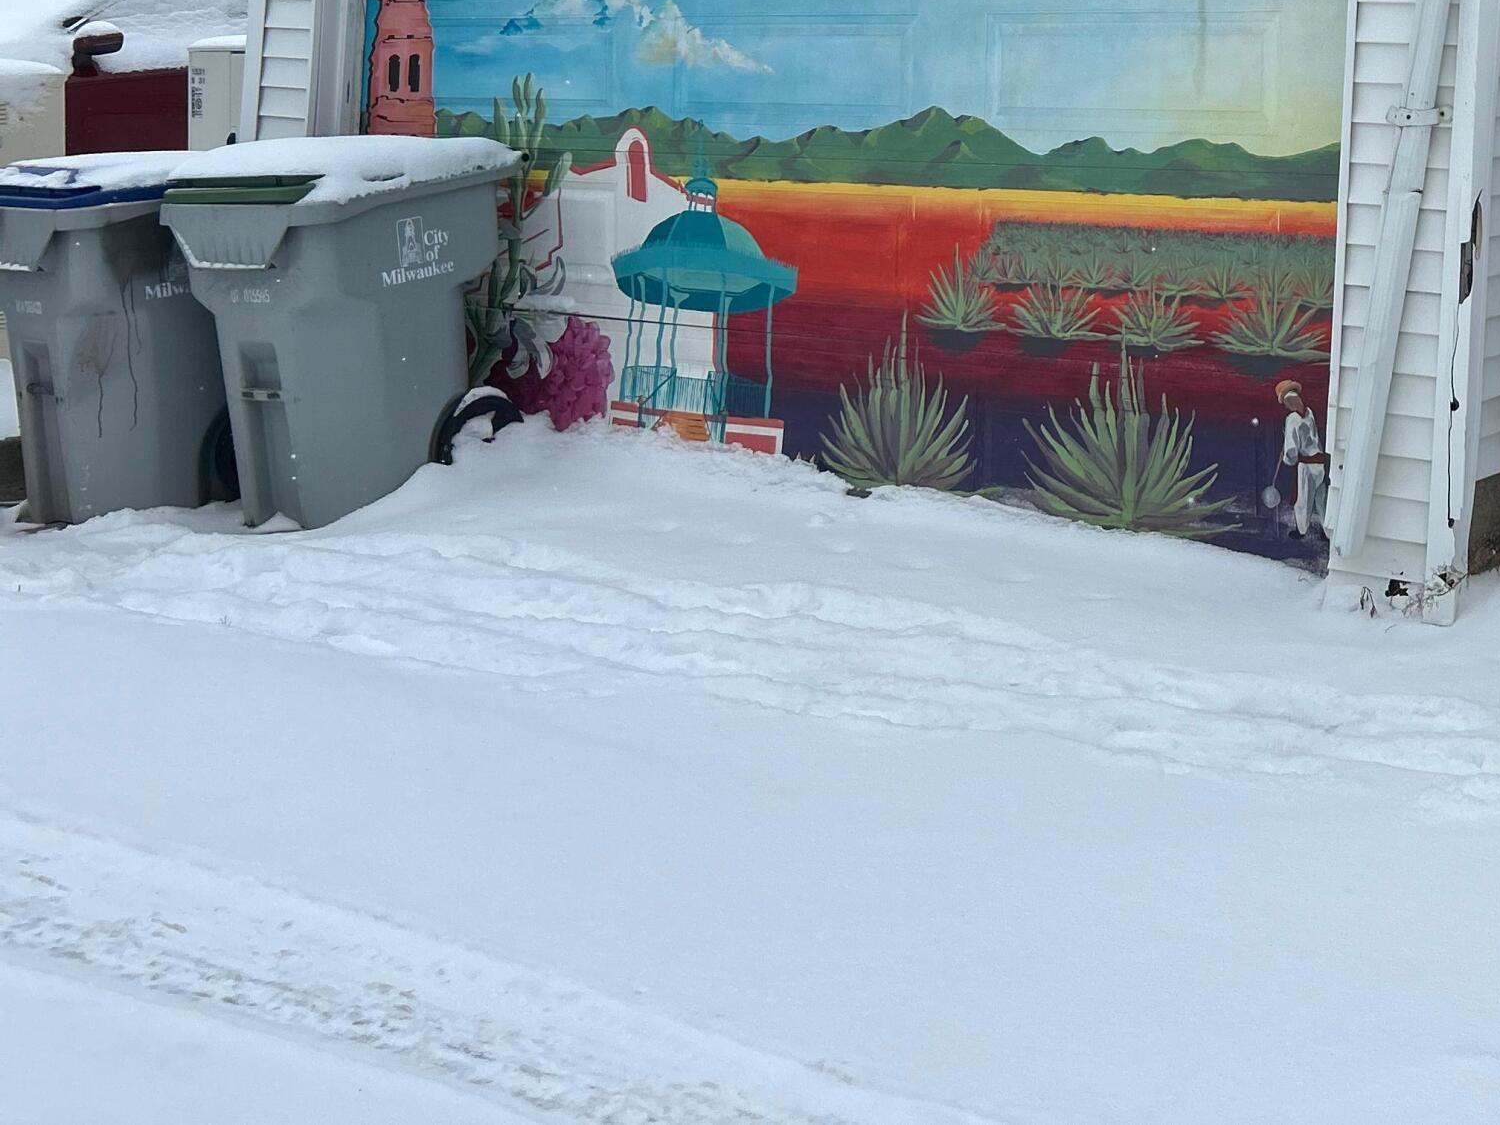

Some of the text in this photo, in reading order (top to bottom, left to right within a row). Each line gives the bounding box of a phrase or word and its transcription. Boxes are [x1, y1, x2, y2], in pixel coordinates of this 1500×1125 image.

[424, 229, 449, 246] City
[426, 244, 440, 262] of
[381, 261, 454, 288] Milwaukee
